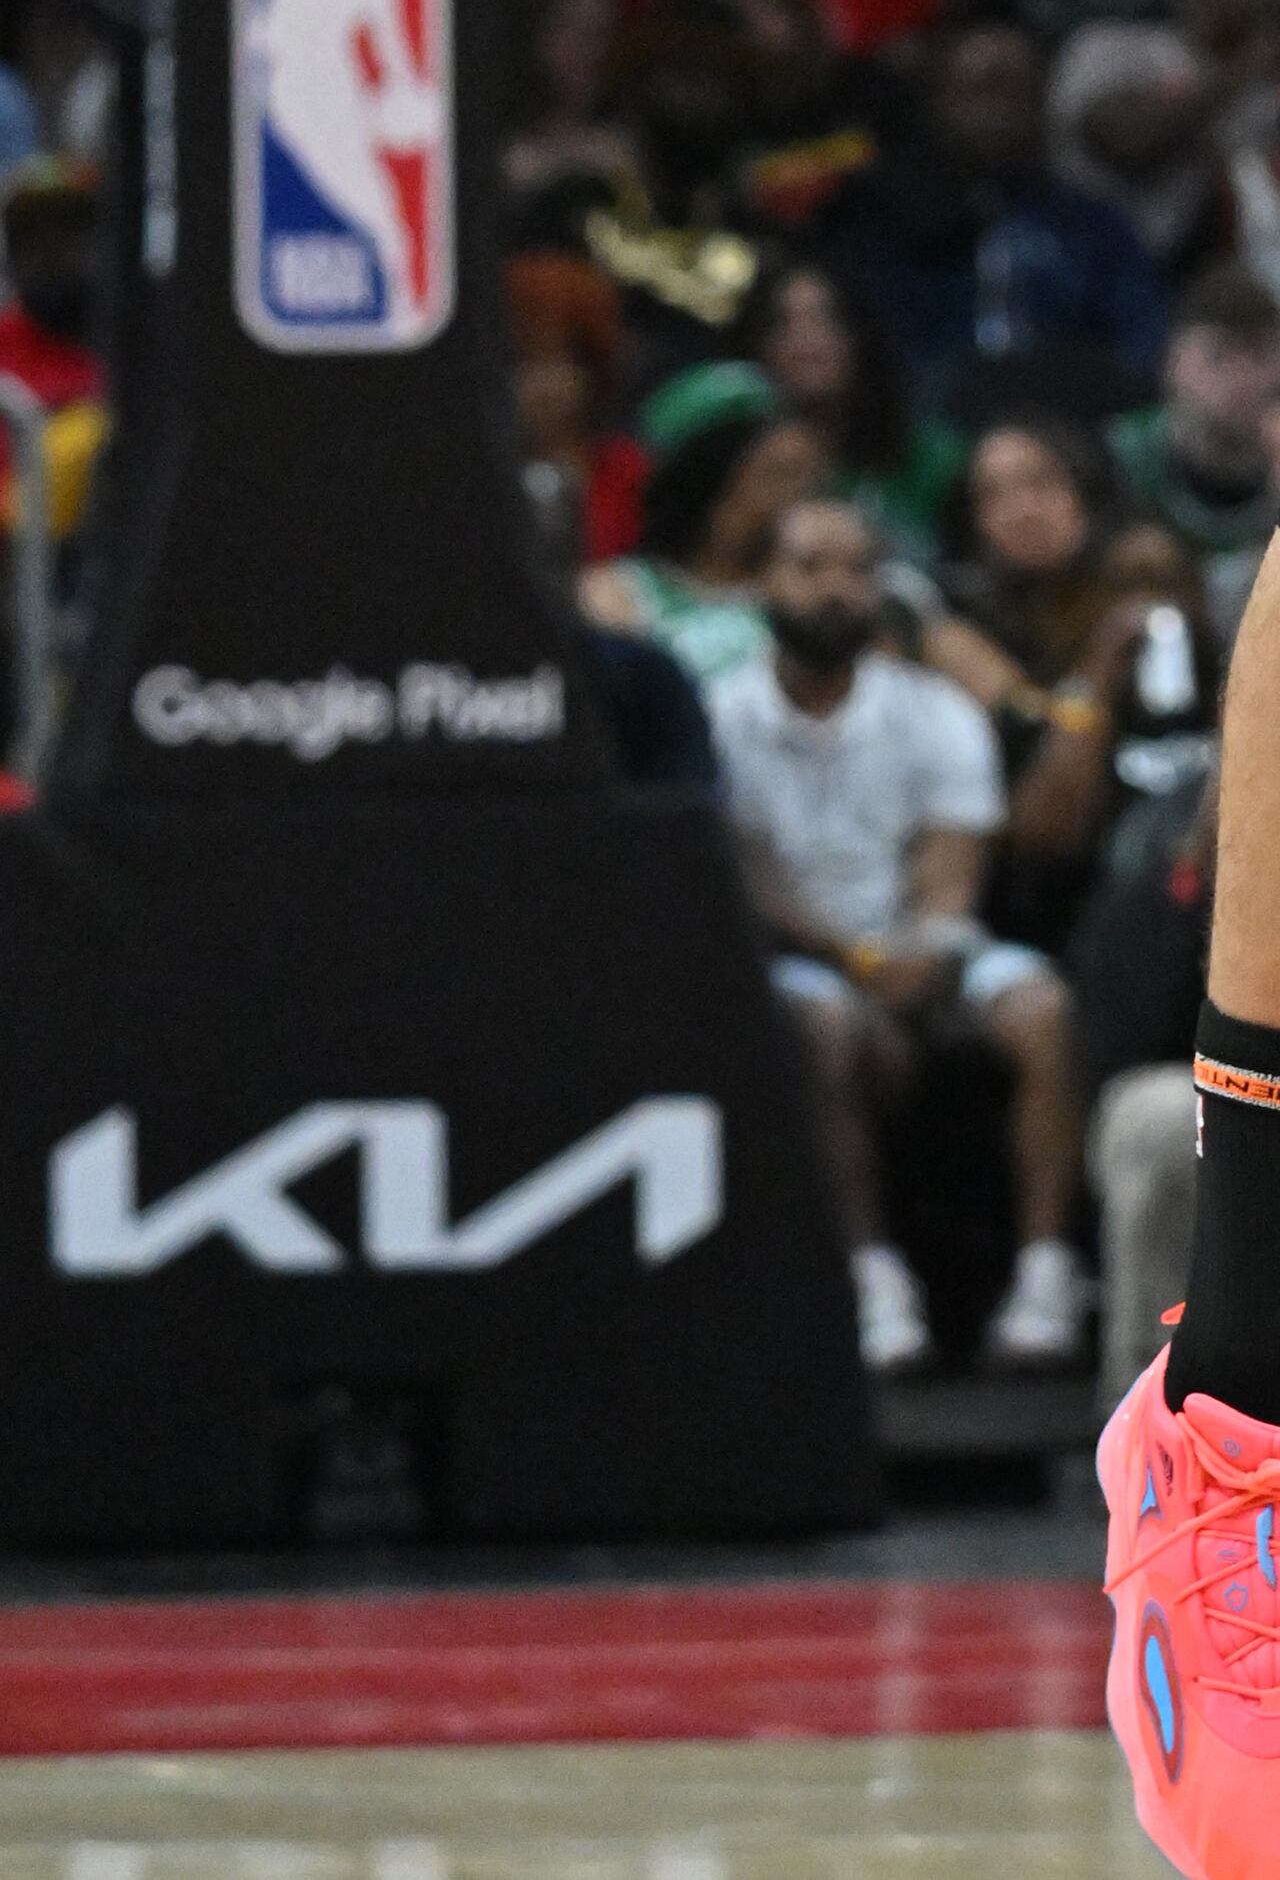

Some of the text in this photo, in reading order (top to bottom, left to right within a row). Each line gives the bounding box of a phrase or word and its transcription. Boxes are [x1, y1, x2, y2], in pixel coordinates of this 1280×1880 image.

[132, 660, 566, 763] Google Pixel
[48, 1093, 725, 1278] KIA
